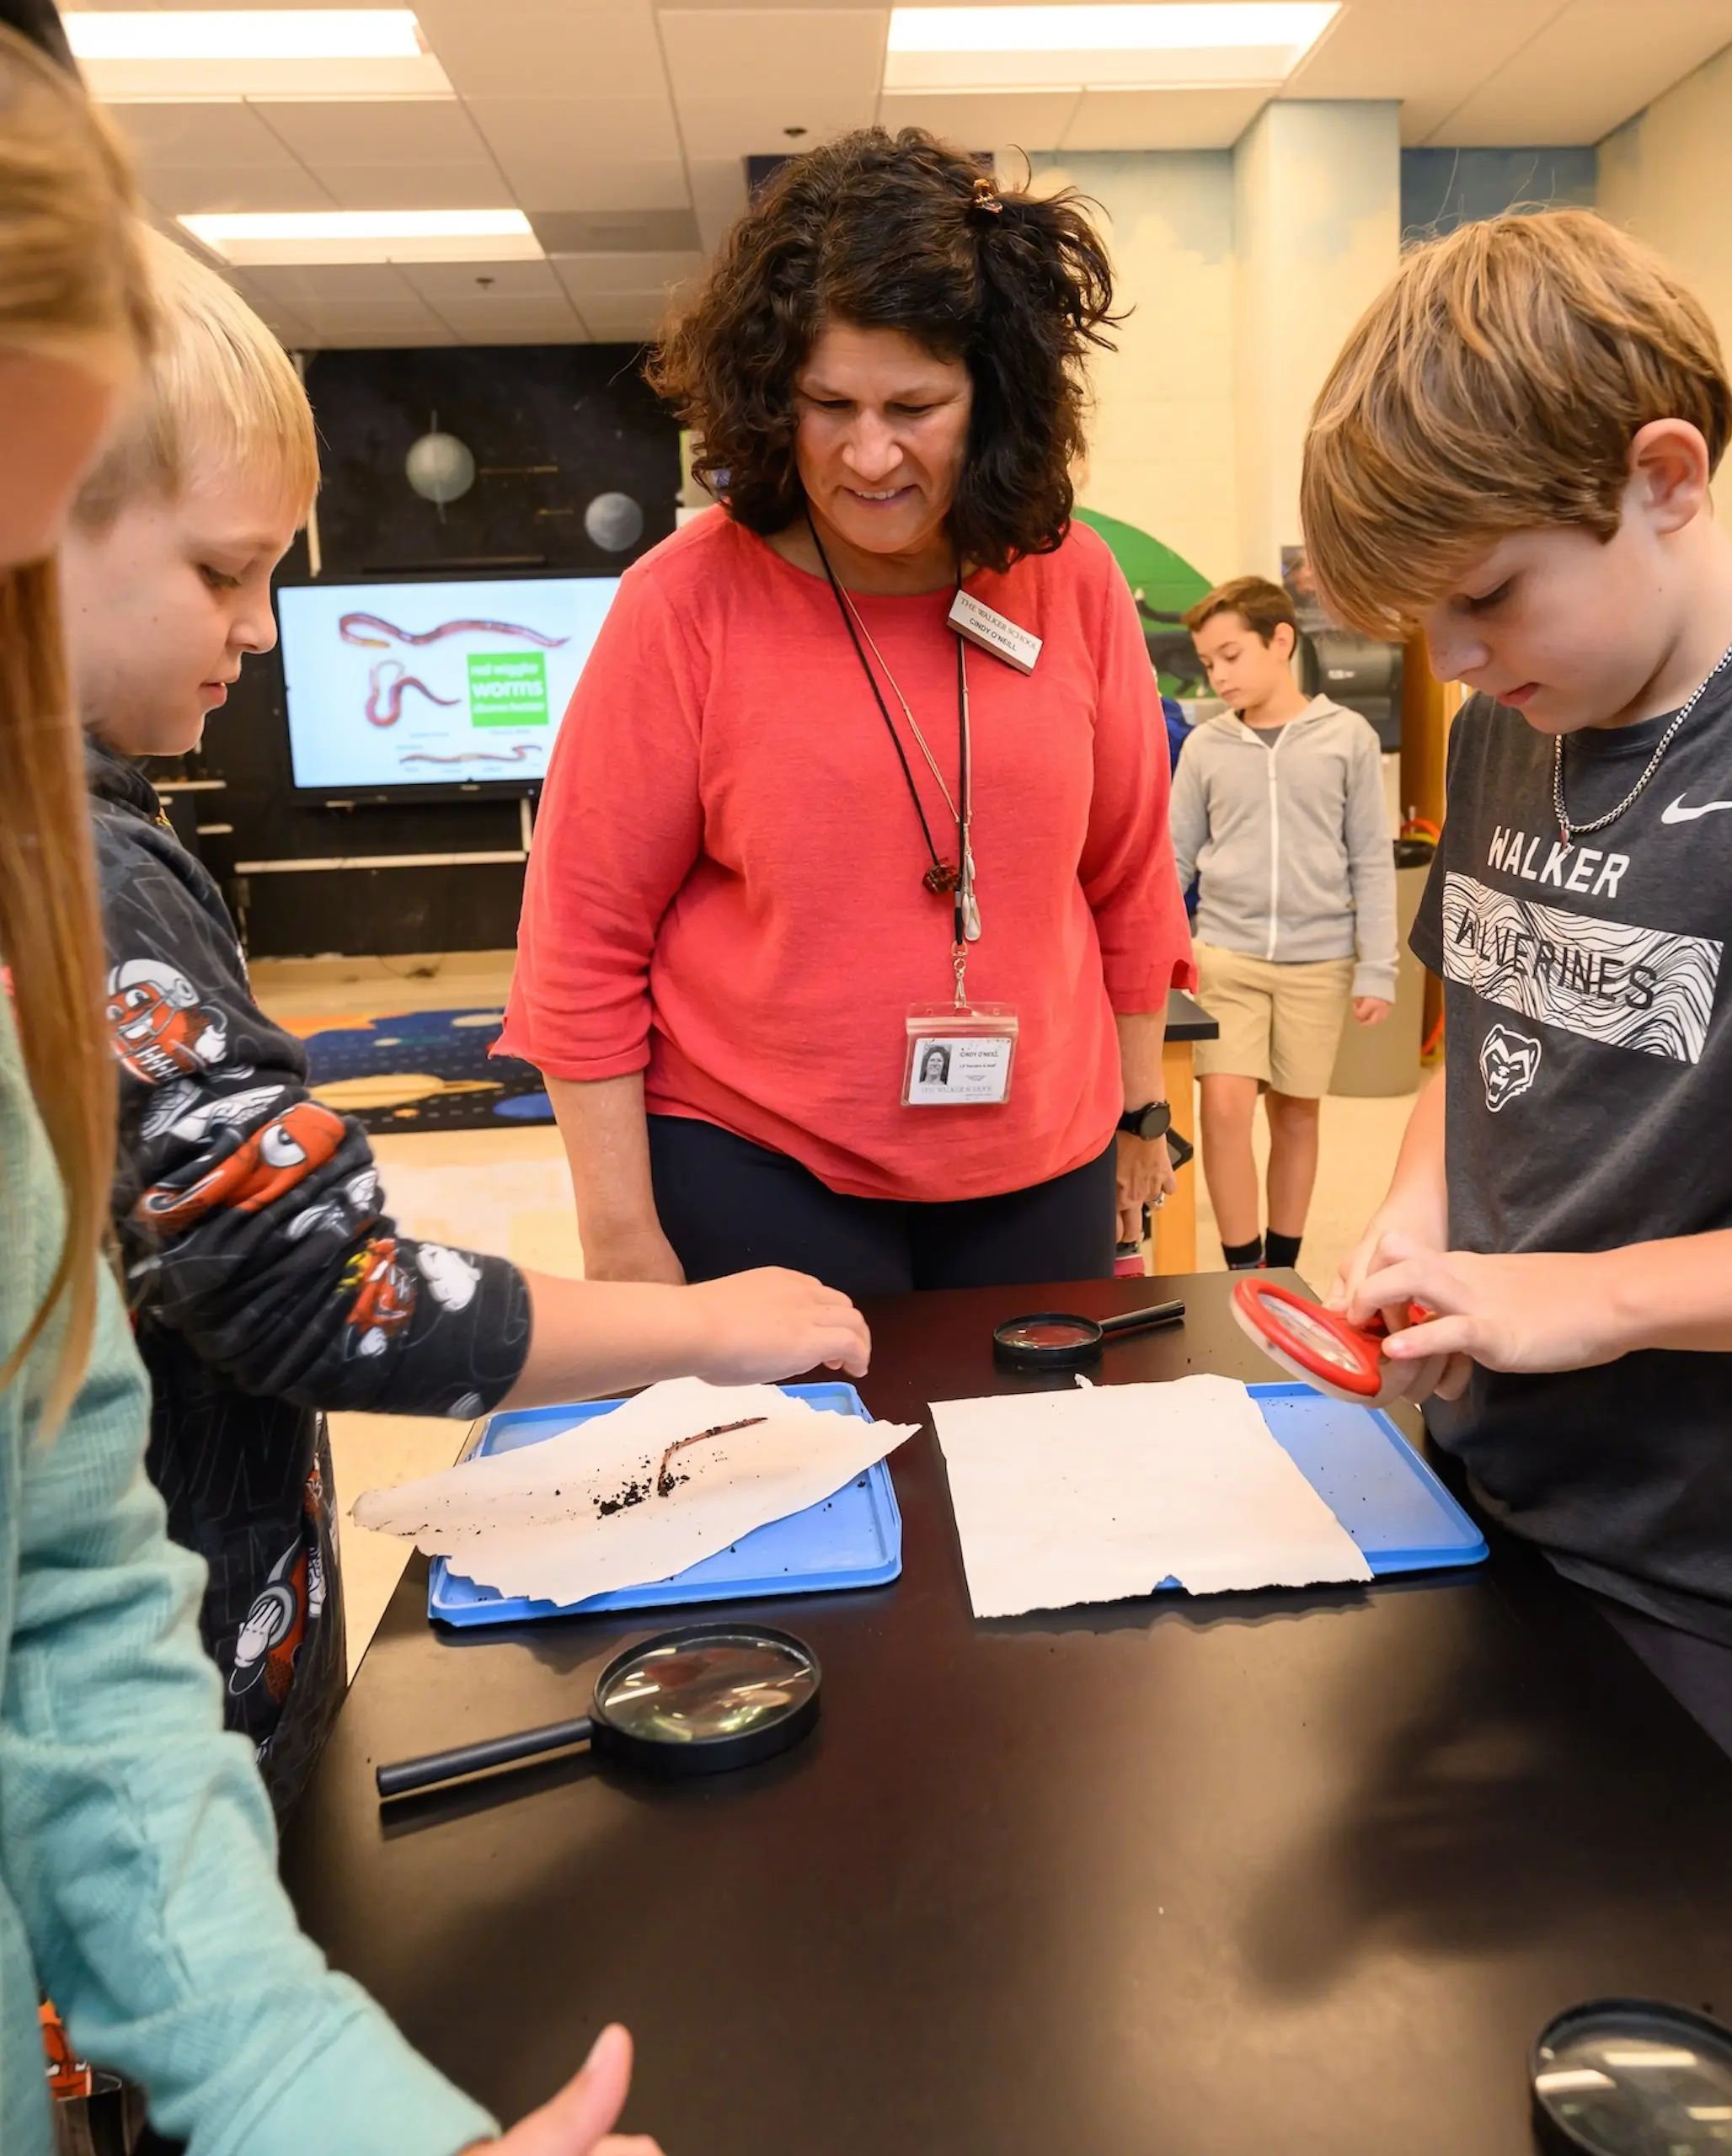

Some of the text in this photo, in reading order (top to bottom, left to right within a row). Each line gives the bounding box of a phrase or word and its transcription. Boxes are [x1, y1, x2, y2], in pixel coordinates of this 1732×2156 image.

[961, 597, 976, 611] THE
[978, 608, 1007, 632] WALKER
[969, 617, 1017, 651] CINDY O'NEILL
[472, 680, 543, 699] worms
[1486, 825, 1631, 899] WALKER
[1454, 907, 1658, 1010] WLVERINES
